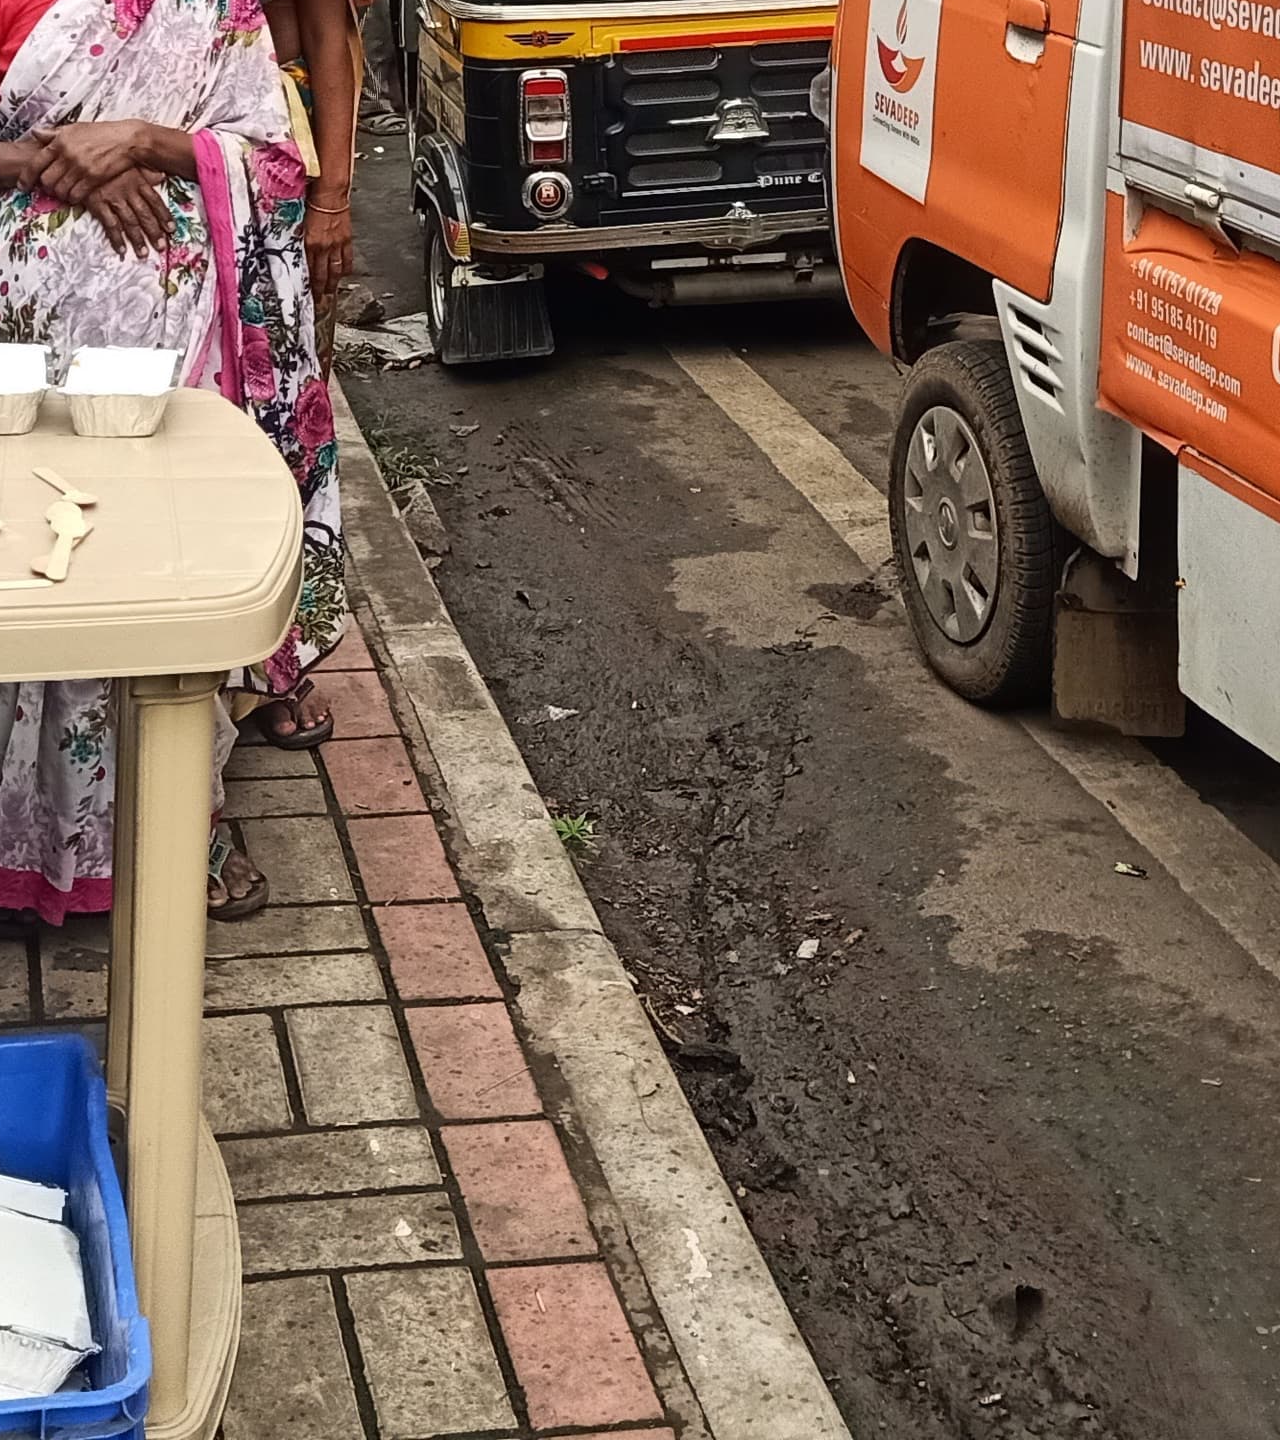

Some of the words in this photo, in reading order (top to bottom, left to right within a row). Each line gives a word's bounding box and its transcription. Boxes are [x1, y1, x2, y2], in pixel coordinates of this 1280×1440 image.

[1140, 39, 1195, 82] www.
[874, 91, 920, 131] SEVADEEP
[756, 174, 802, 188] Pune
[1131, 259, 1150, 282] +91
[1153, 265, 1184, 297] 91752
[1186, 280, 1223, 316] 01229
[1129, 289, 1149, 314] +91
[1151, 297, 1184, 330] 95185
[1185, 315, 1217, 349] 41719
[1127, 321, 1241, 397] contact@sevadeep.com
[1157, 370, 1228, 423] sevadeep.com
